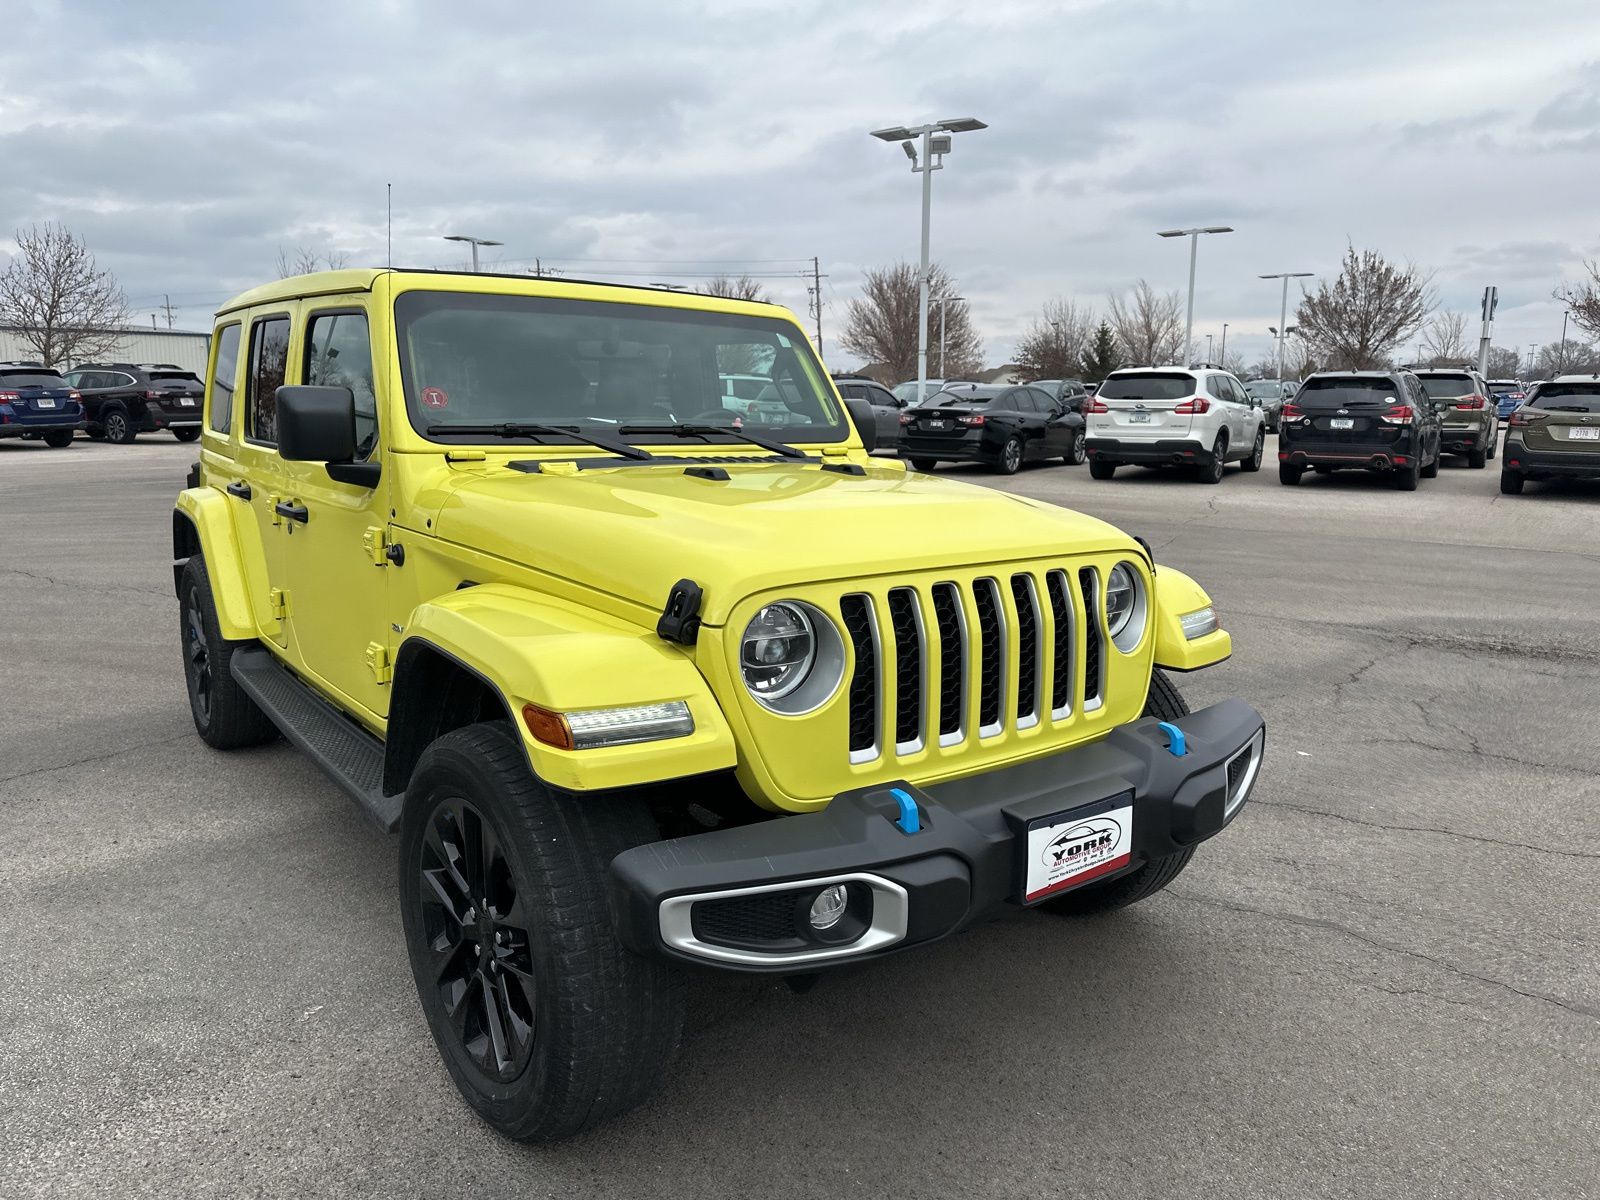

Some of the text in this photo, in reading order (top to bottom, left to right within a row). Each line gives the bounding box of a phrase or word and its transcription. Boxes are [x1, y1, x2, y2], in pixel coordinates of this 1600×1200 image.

[1052, 833, 1112, 860] YORK
[1053, 850, 1090, 867] AUTOMOTIVE
[1092, 842, 1112, 853] GROUP
